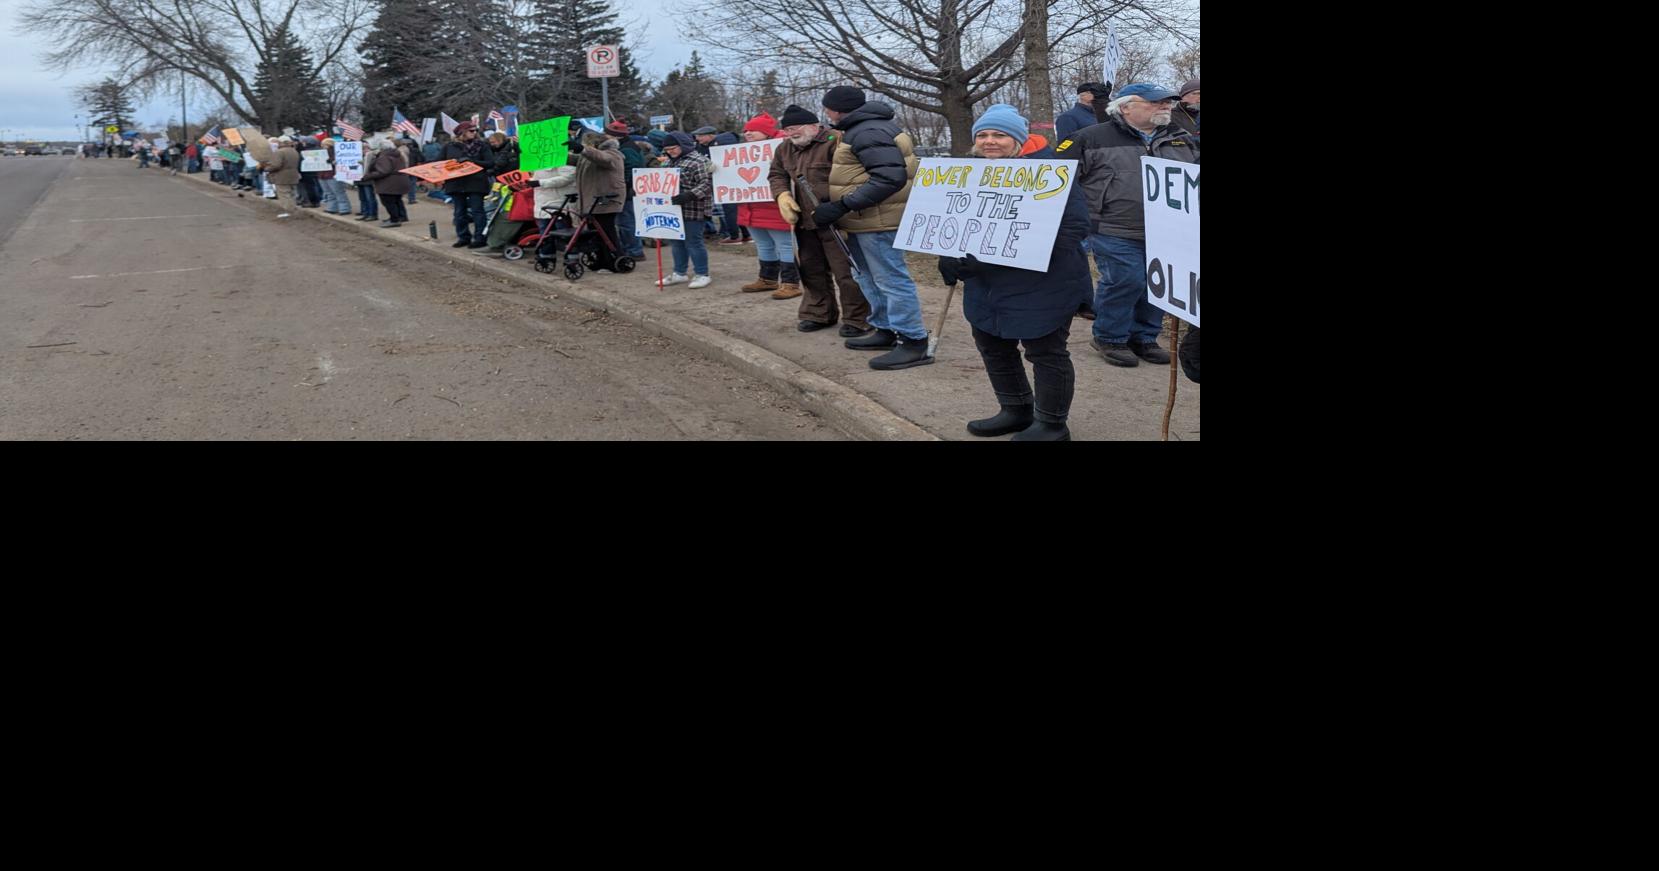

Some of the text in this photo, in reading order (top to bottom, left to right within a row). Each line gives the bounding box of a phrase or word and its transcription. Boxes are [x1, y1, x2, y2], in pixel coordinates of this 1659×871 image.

[528, 135, 560, 154] GREAT
[723, 143, 772, 167] MAGA
[503, 172, 522, 184] NO
[635, 172, 661, 195] GRAB
[914, 164, 1069, 200] POWER BELONGS
[1145, 164, 1200, 216] DEM
[946, 191, 1023, 219] TO THE
[906, 213, 1031, 258] PEOPLE
[1147, 257, 1200, 316] OLI
